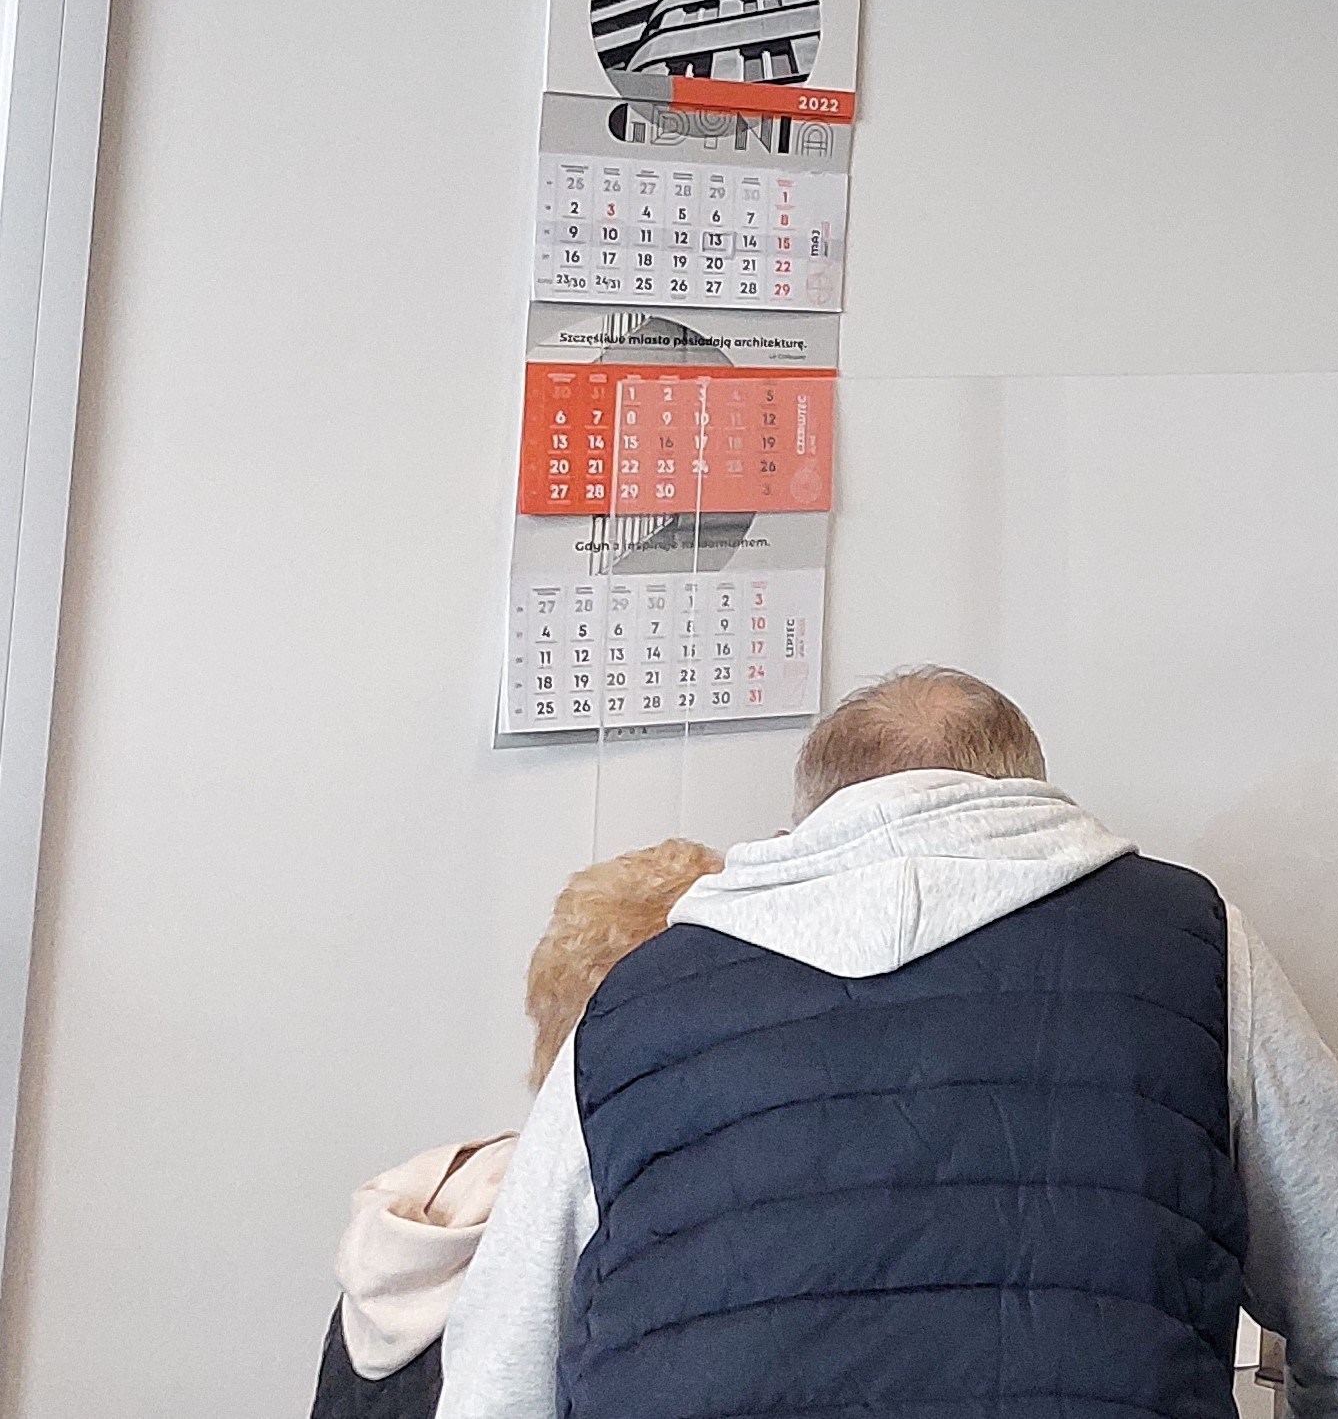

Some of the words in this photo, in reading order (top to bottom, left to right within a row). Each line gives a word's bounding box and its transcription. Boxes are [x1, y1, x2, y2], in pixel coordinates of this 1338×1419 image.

[799, 96, 839, 112] 2022
[570, 202, 578, 214] 2
[642, 206, 651, 218] 4
[712, 210, 721, 222] 6
[747, 212, 755, 224] 7
[569, 226, 578, 238] 9
[603, 228, 618, 240] 10
[641, 230, 651, 242] 11
[675, 231, 688, 244] 12
[709, 234, 722, 246] 13
[743, 235, 757, 248] 14
[565, 250, 580, 262] 16
[603, 252, 616, 264] 17
[638, 254, 652, 266] 18
[674, 256, 687, 267] 19
[706, 257, 723, 269] 20
[743, 260, 756, 271] 21
[775, 261, 791, 272] 22
[636, 278, 652, 290] 25
[671, 280, 688, 292] 26
[706, 282, 721, 293] 27
[740, 283, 756, 294] 28
[774, 284, 790, 296] 29
[628, 335, 670, 346] miasto
[664, 388, 673, 401] 2
[555, 411, 566, 424] 6
[592, 411, 602, 425] 7
[588, 435, 604, 448] 14
[660, 437, 673, 448] 16
[763, 437, 775, 449] 19
[550, 460, 569, 473] 20
[588, 460, 603, 473] 21
[621, 460, 639, 473] 22
[760, 460, 776, 472] 26
[550, 484, 569, 499] 27
[575, 541, 620, 552] Gdyna
[722, 595, 729, 607] 2
[542, 626, 550, 638] 4
[578, 624, 587, 637] 5
[614, 623, 623, 635] 6
[651, 622, 659, 634] 7
[721, 619, 729, 630] 9
[752, 617, 765, 630] 10
[540, 651, 551, 665] 11
[575, 650, 589, 662] 12
[610, 648, 624, 661] 13
[646, 647, 661, 659] 14
[717, 643, 730, 655] 16
[752, 641, 763, 653] 17
[537, 676, 552, 690] 18
[574, 675, 589, 688] 19
[607, 673, 625, 686] 20
[645, 672, 660, 684] 21
[714, 667, 730, 680] 23
[748, 666, 764, 678] 24
[537, 702, 554, 715] 25
[573, 700, 591, 713] 26
[608, 698, 625, 711] 27
[643, 696, 661, 708] 28
[712, 692, 730, 704] 30
[750, 689, 762, 702] 31
